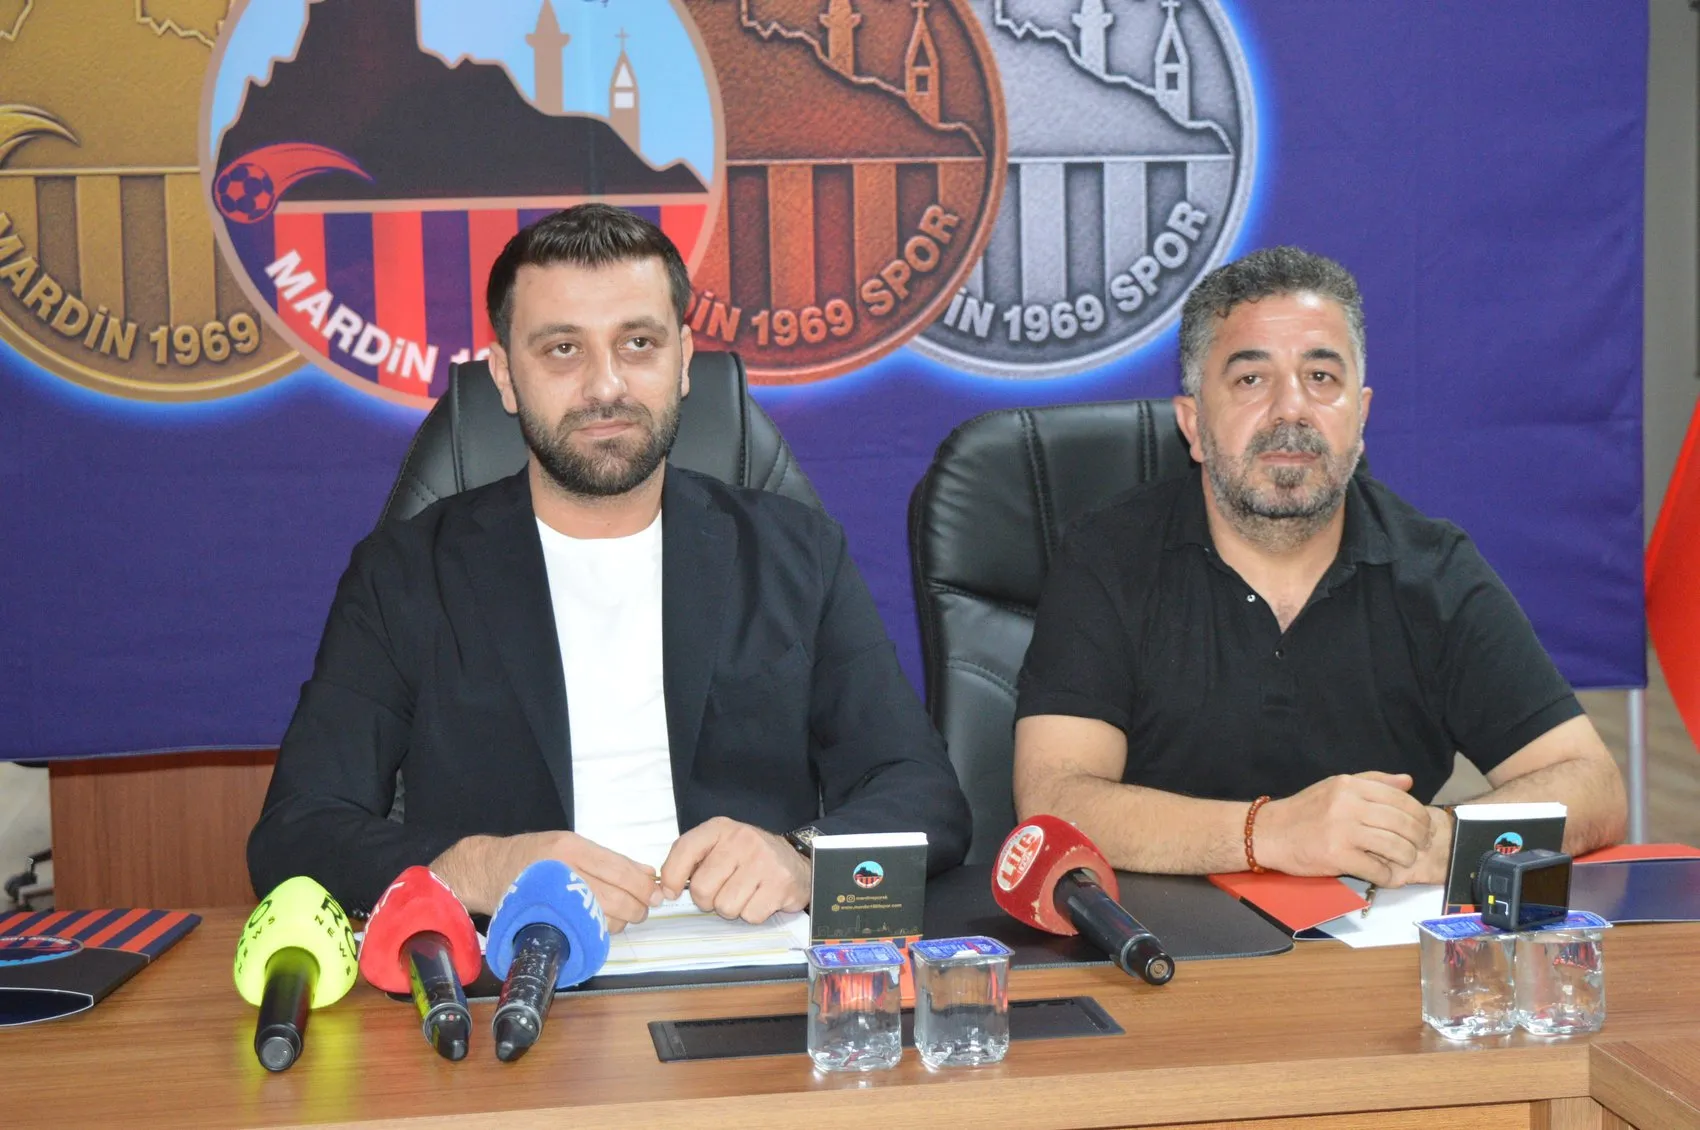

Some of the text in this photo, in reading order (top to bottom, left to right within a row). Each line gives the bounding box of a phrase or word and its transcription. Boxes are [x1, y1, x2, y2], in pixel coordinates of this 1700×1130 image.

[150, 312, 260, 366] 1969
[751, 299, 854, 347] 1969
[861, 204, 960, 317] SPOR
[1003, 294, 1105, 343] 1969
[1110, 201, 1209, 313] SPOR
